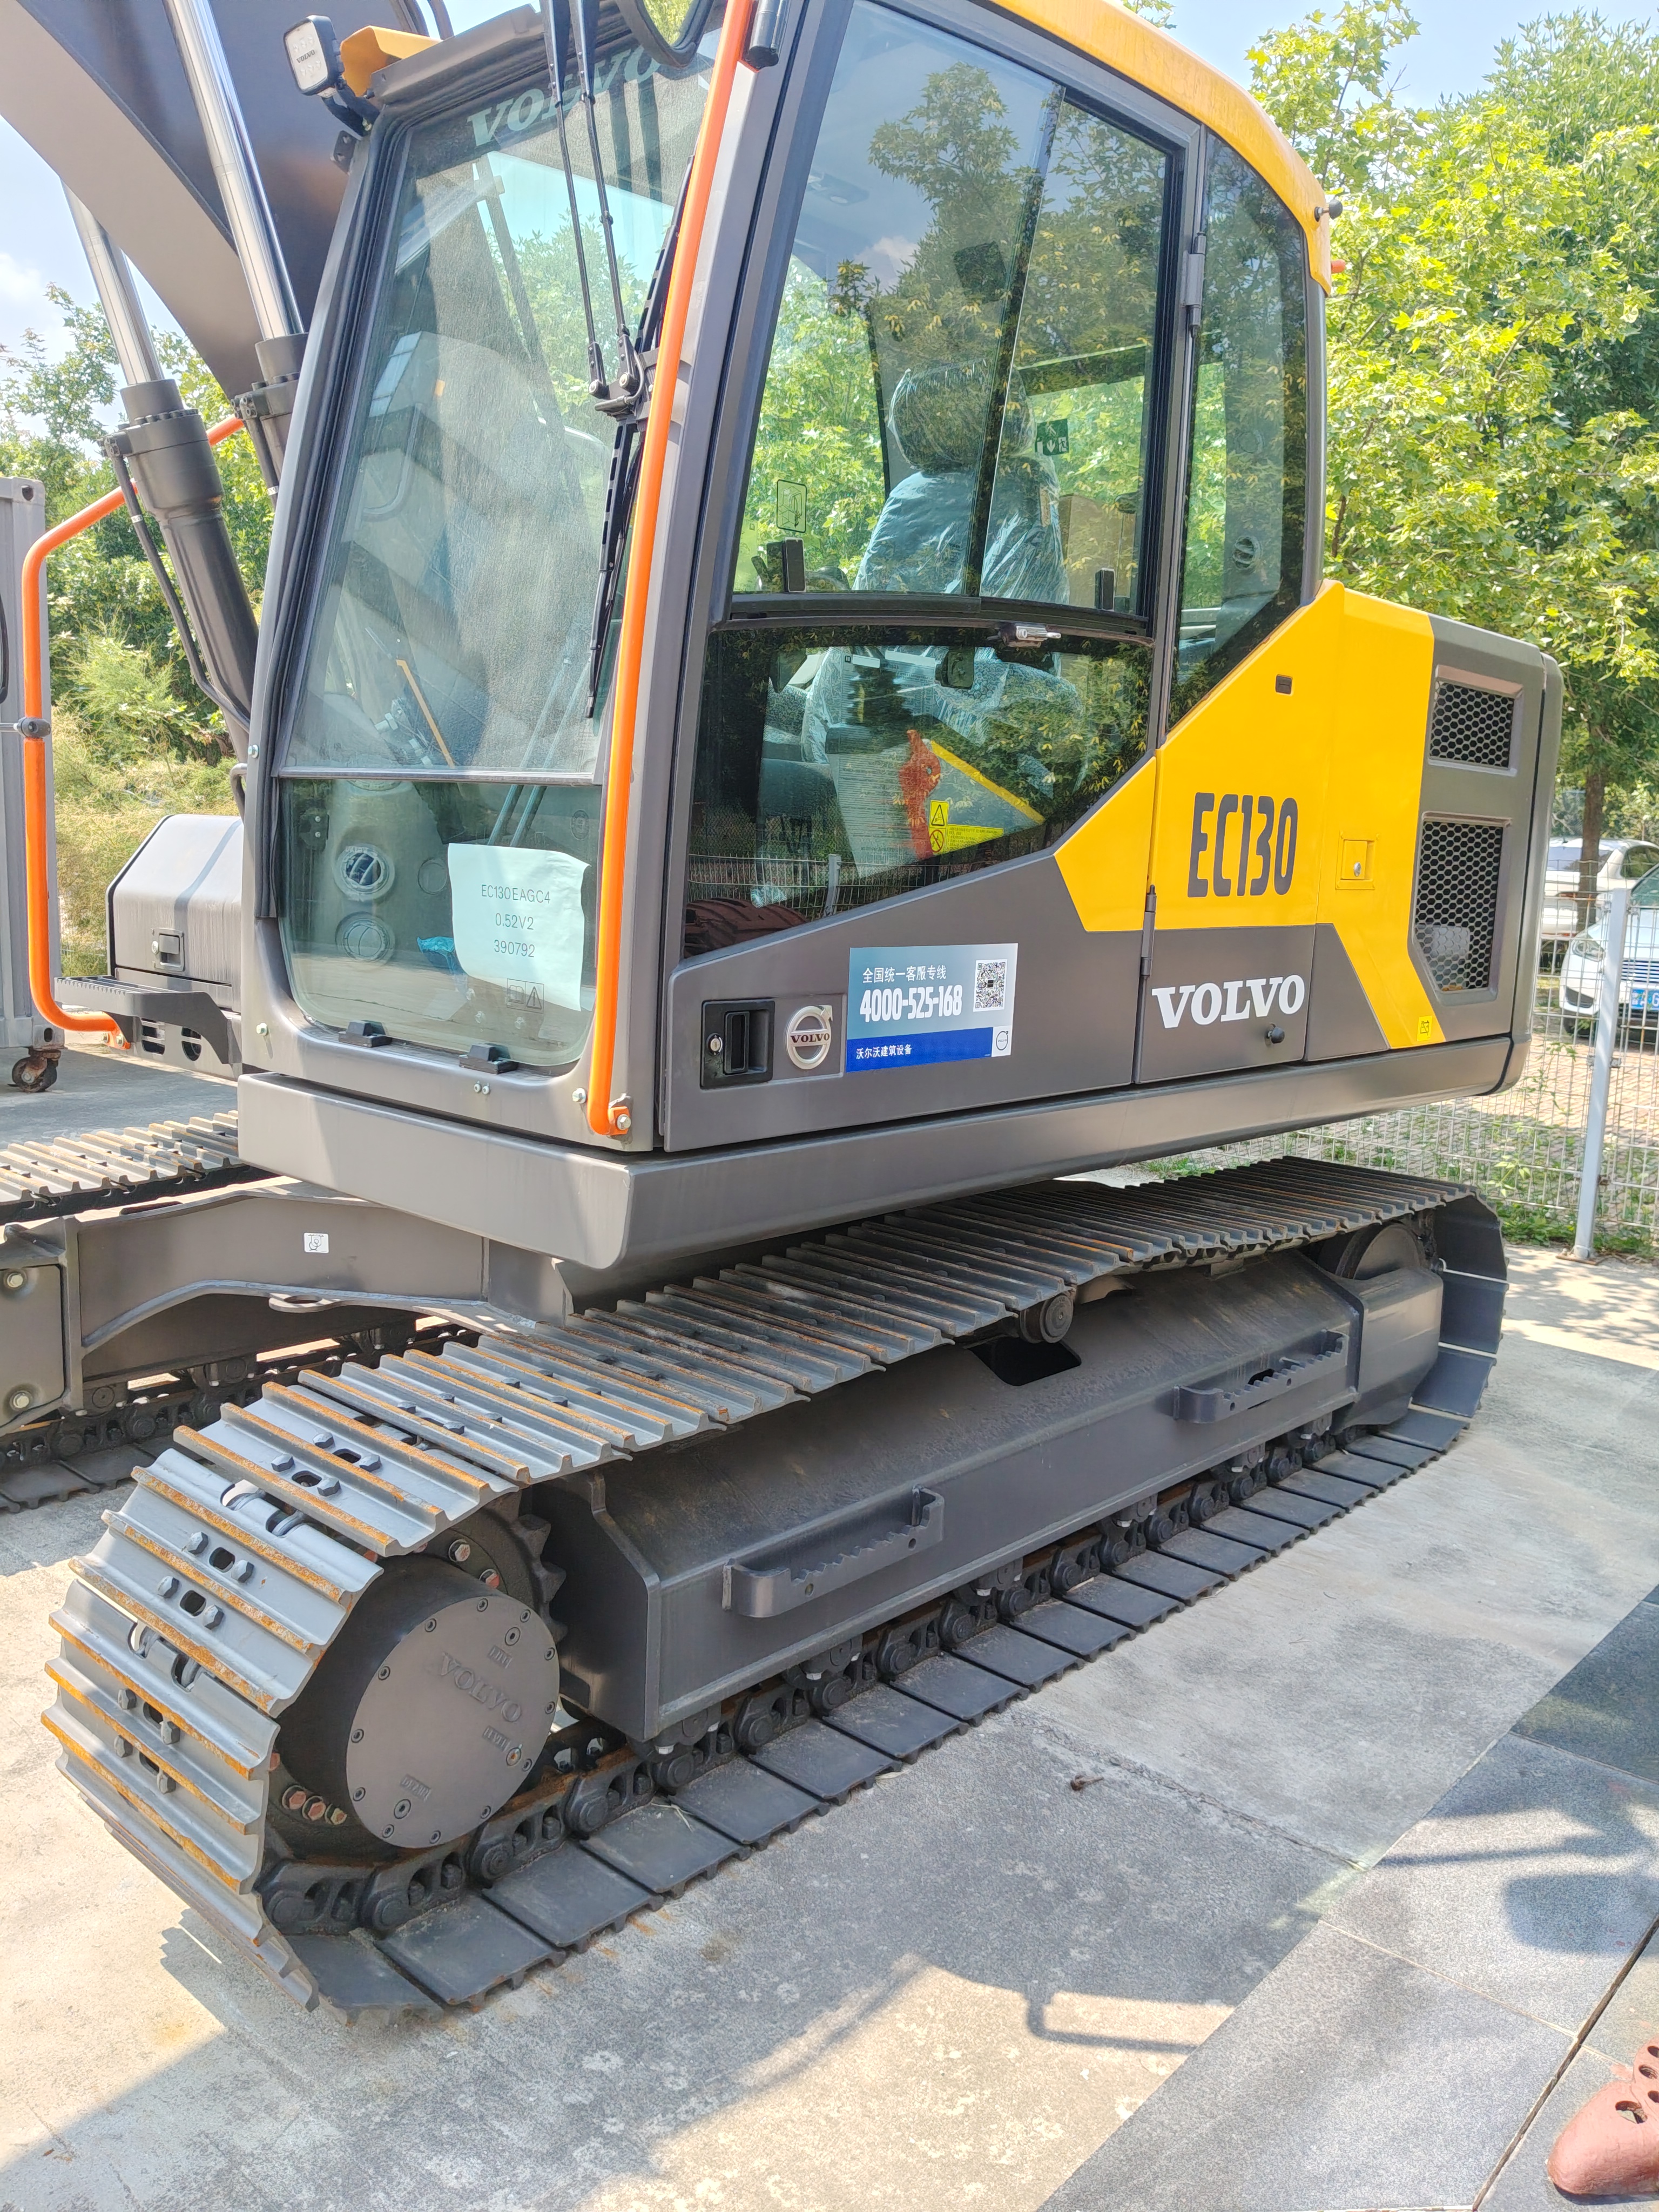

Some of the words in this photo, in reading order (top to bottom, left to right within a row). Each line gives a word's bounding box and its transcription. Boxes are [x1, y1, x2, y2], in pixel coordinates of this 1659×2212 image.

[296, 49, 315, 63] VOLVO
[1188, 792, 1298, 898] EC130
[481, 884, 551, 905] EC130EAGC4
[495, 913, 534, 930] 0.52V2
[494, 939, 535, 958] 390792
[862, 965, 947, 984] 全国统一客服专线
[860, 984, 963, 1023] 4000-525-168
[1151, 974, 1305, 1029] VOLVO
[790, 1033, 830, 1043] VOLVO
[855, 1043, 912, 1060] 沃尔沃建筑设备
[441, 1651, 522, 1723] VOLVO
